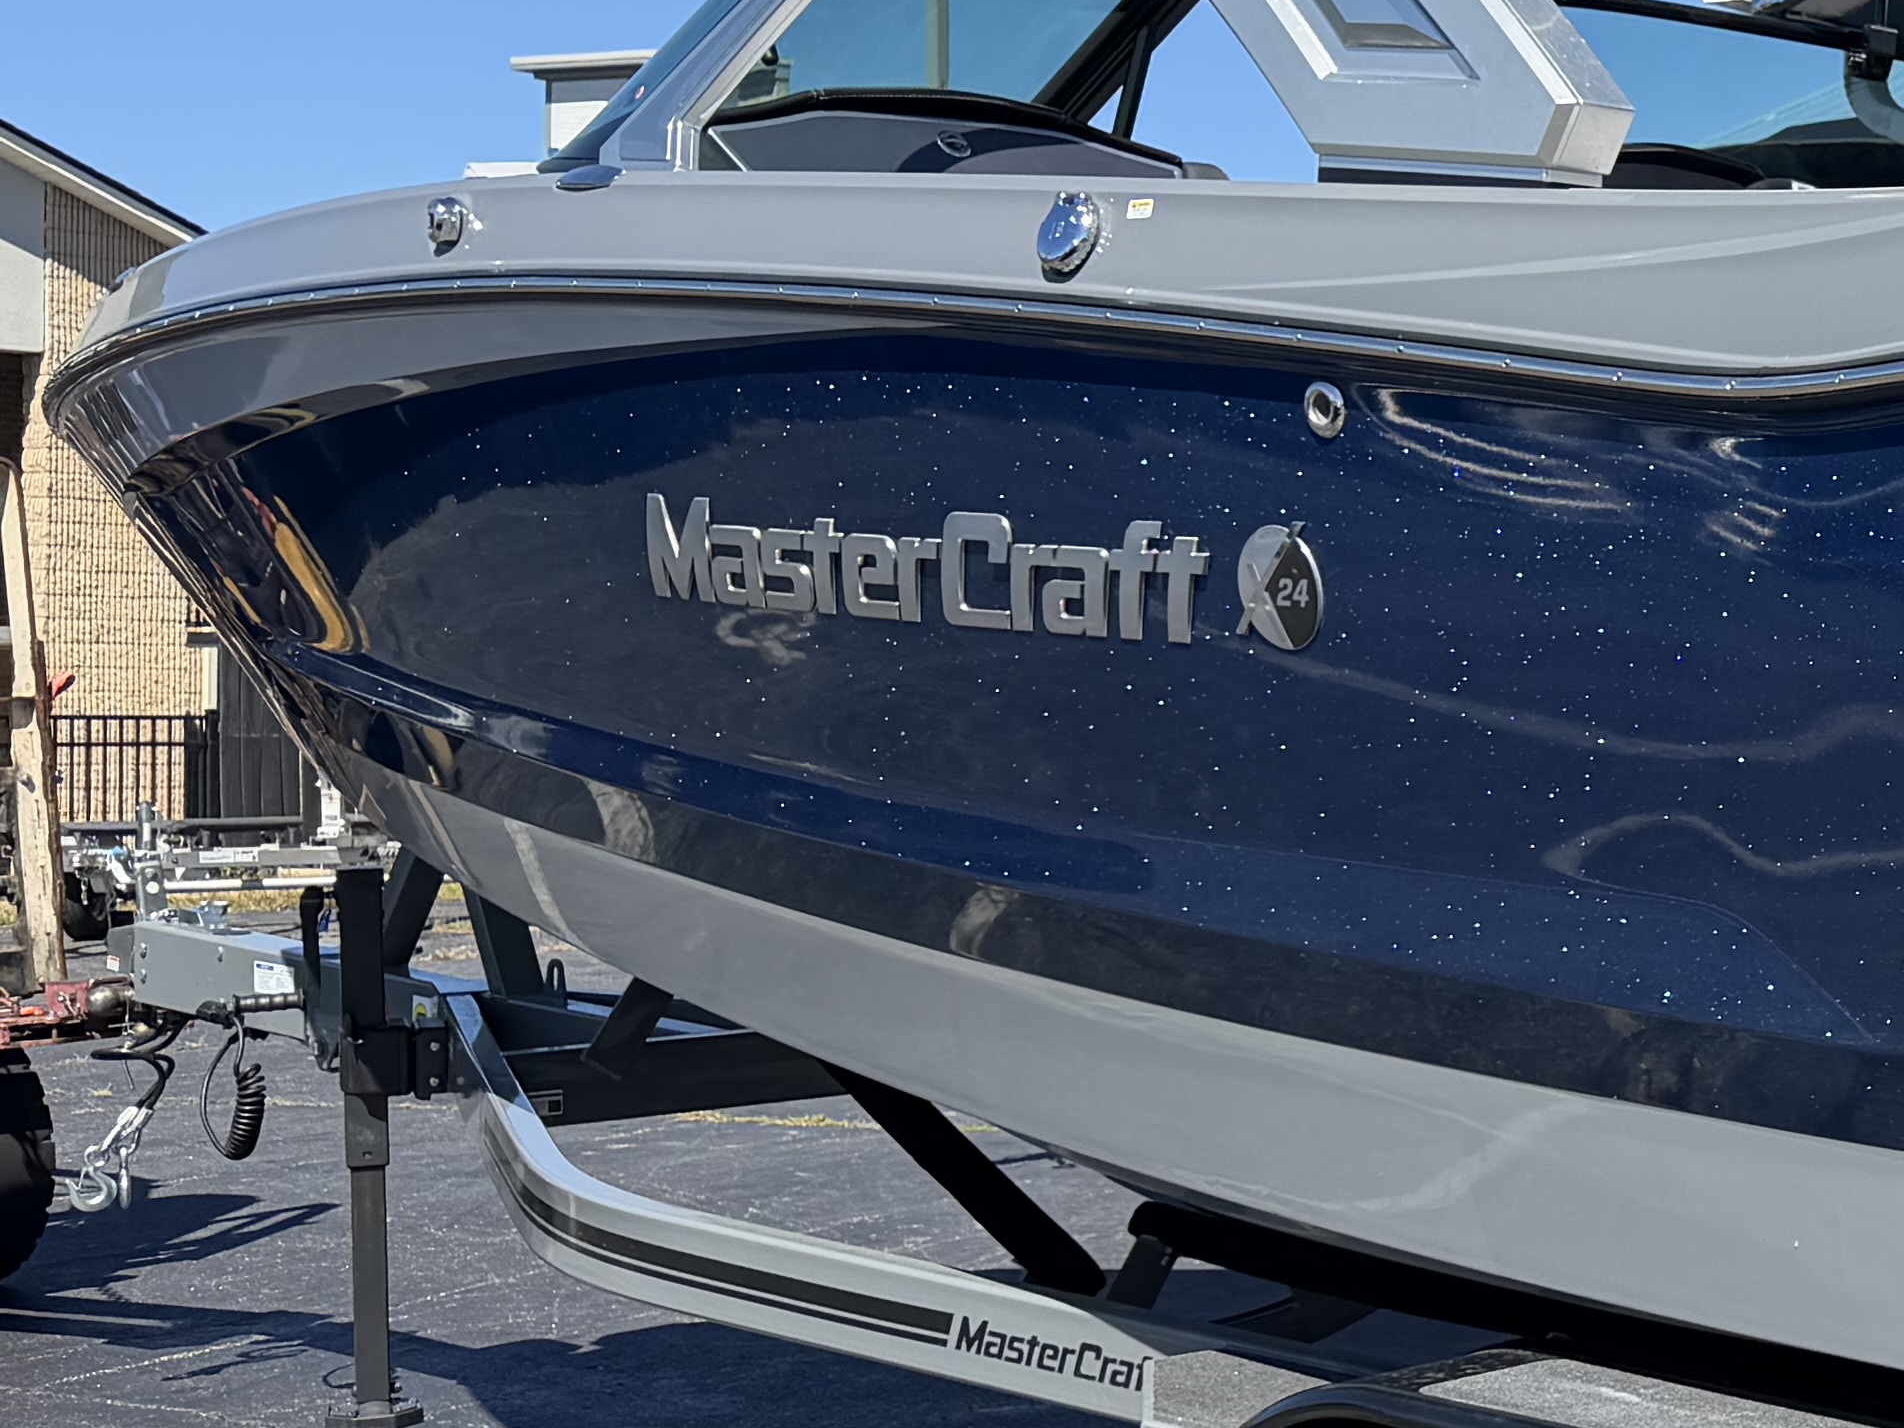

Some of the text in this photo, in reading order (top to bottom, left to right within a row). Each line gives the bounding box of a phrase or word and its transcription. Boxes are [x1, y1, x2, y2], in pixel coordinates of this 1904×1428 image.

[646, 492, 1210, 644] MasterCraft
[1276, 576, 1310, 609] 24
[955, 1315, 1154, 1392] MasterCraf
